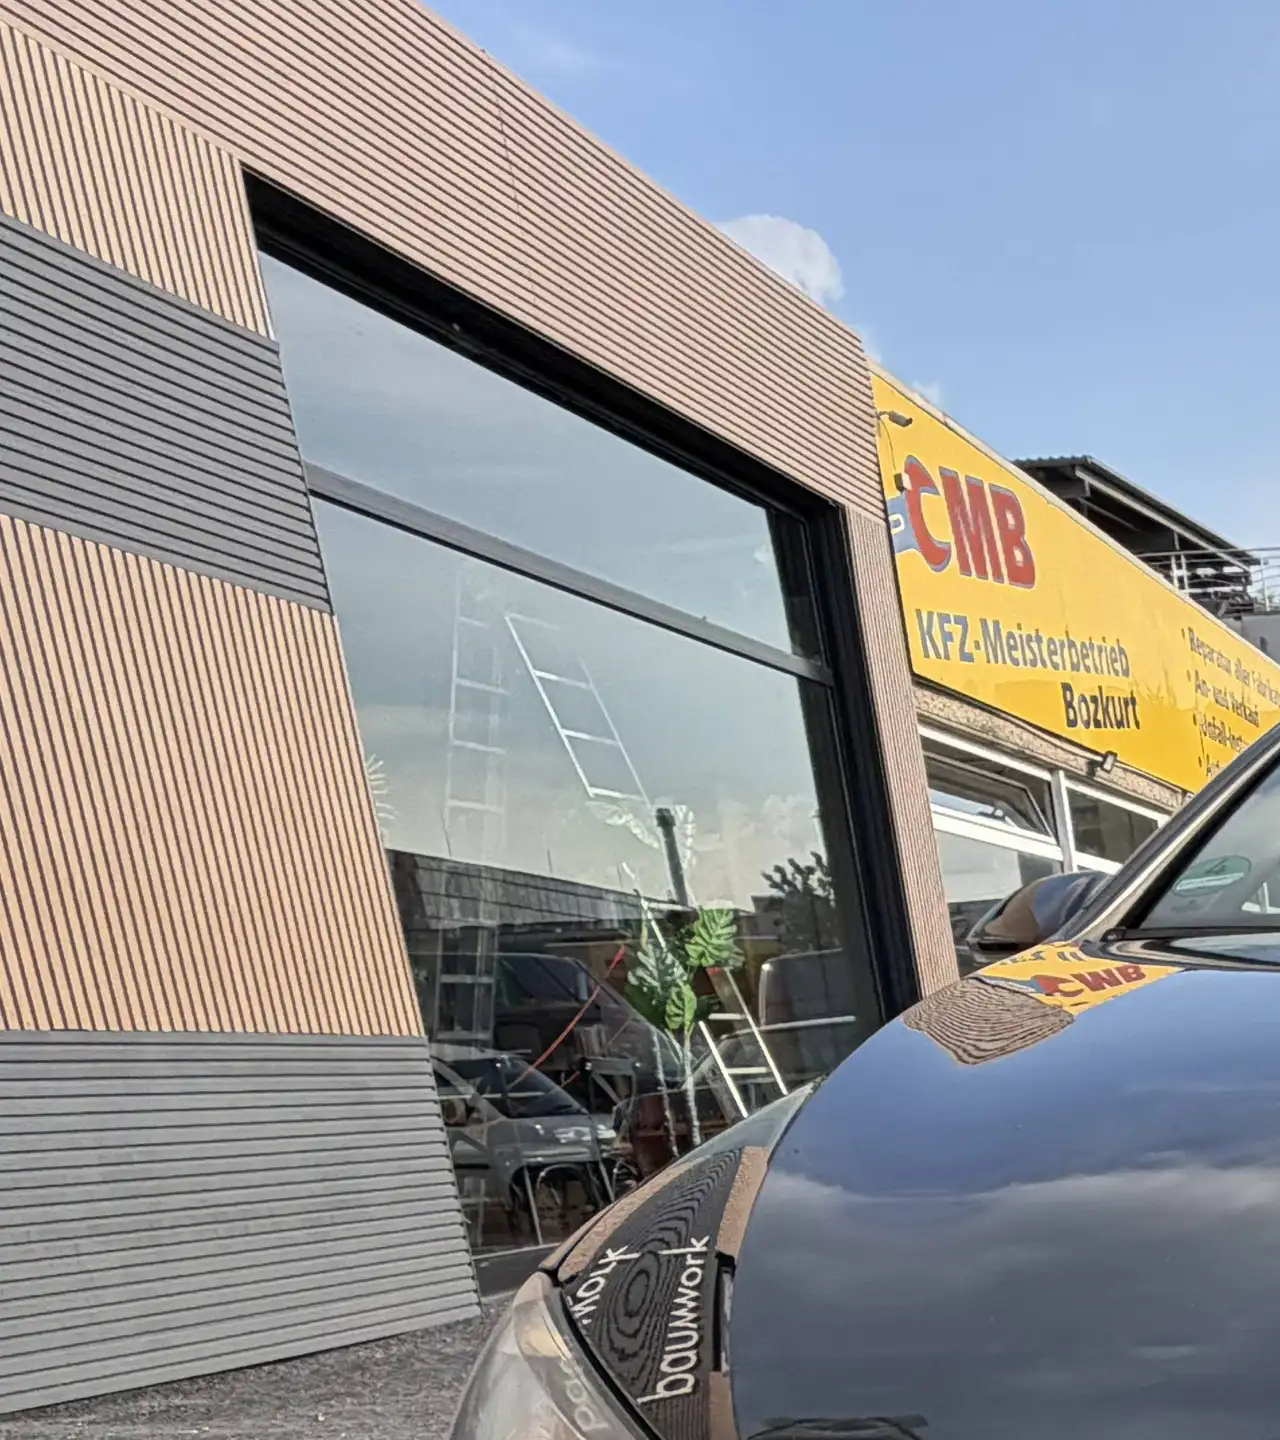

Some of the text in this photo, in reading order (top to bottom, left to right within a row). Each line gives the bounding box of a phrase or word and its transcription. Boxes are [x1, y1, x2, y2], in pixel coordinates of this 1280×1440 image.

[904, 455, 1036, 589] CMB
[915, 608, 1130, 678] KFZ-Meisterbetrieb
[1061, 681, 1141, 730] Bozkurt
